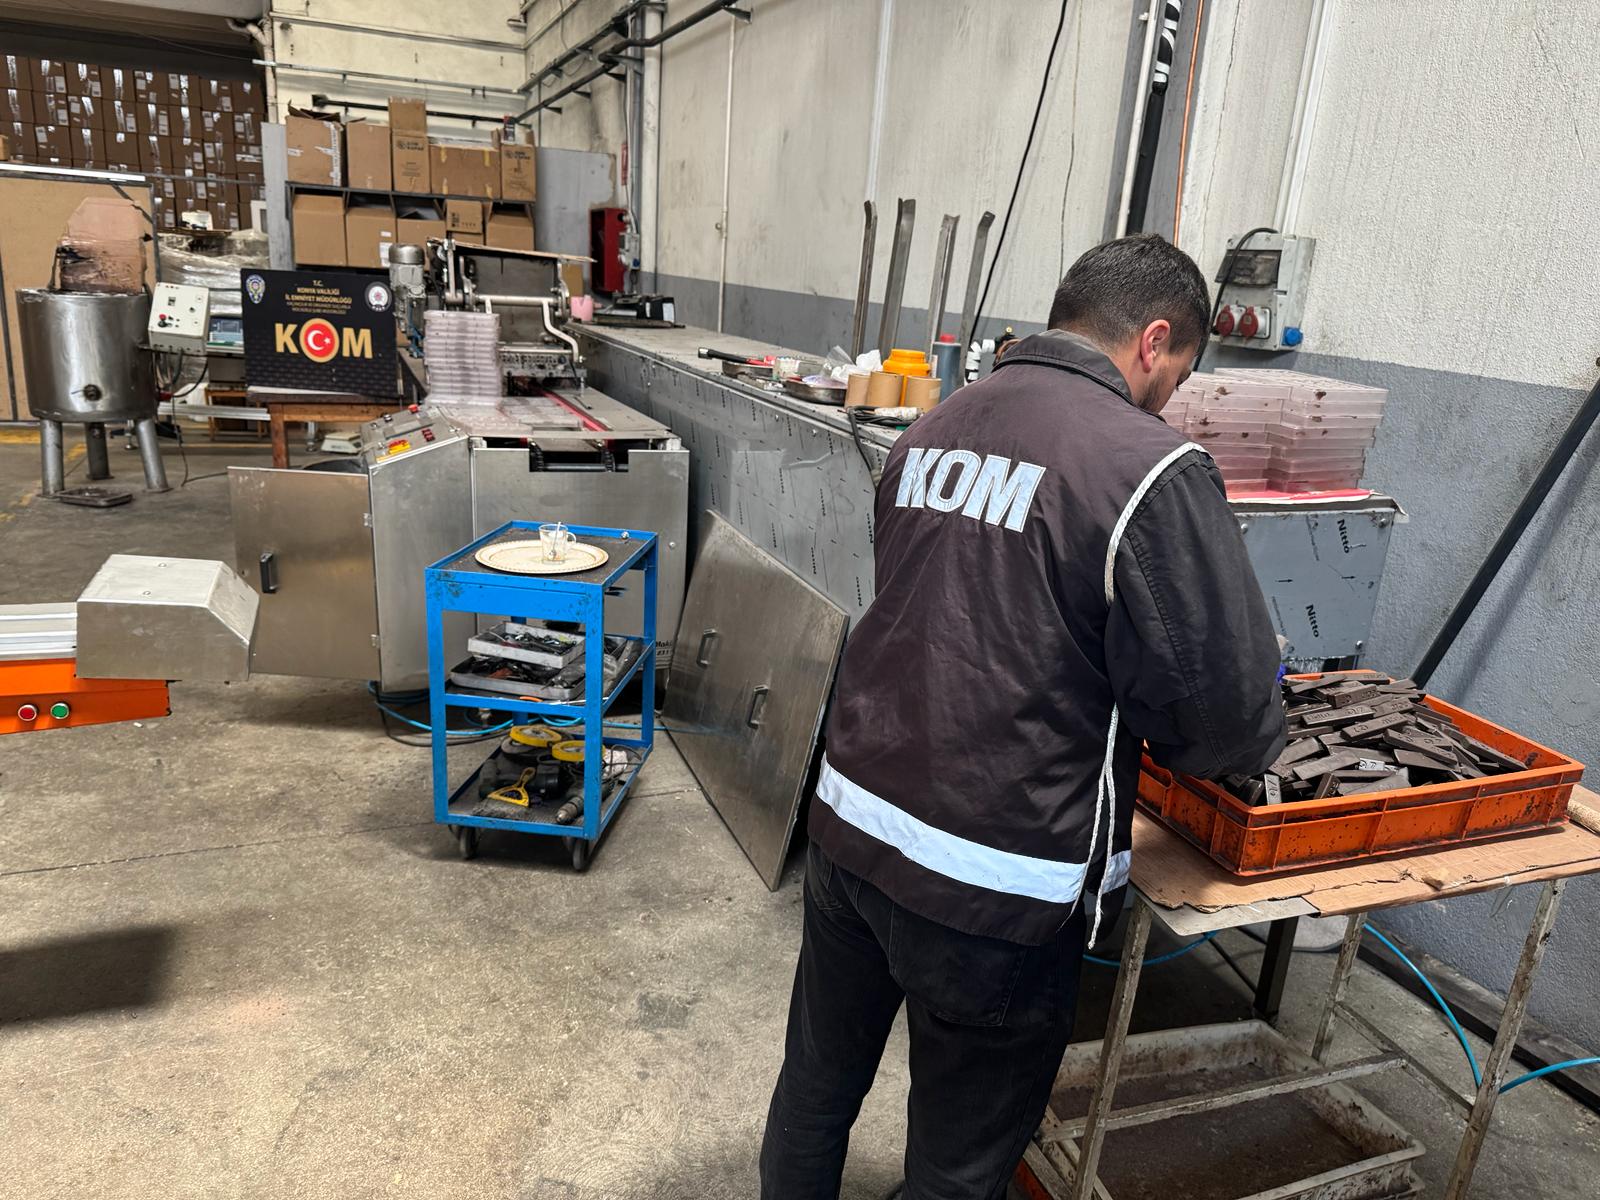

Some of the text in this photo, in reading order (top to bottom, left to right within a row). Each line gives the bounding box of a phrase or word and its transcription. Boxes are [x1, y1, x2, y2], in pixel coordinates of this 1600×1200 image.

[274, 317, 373, 363] KOM
[895, 448, 1047, 533] KOM
[1337, 518, 1351, 554] Nitto
[1305, 604, 1320, 638] Nitto
